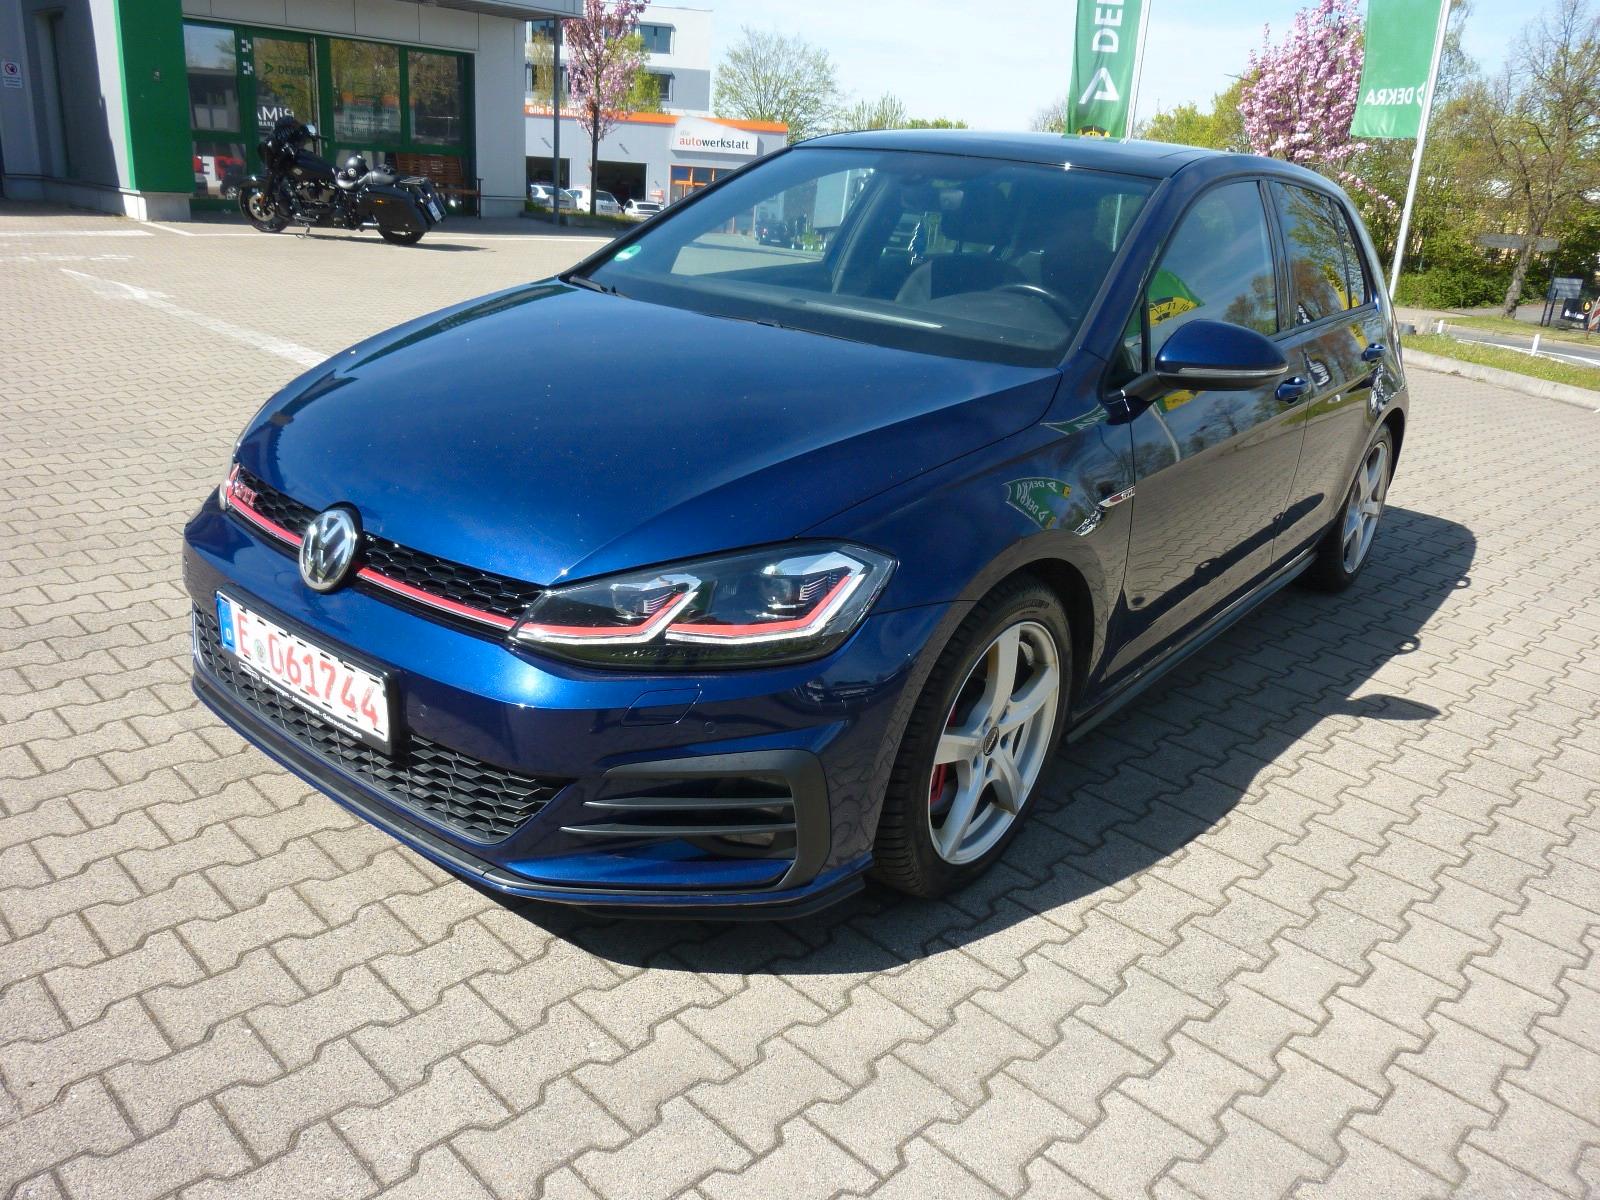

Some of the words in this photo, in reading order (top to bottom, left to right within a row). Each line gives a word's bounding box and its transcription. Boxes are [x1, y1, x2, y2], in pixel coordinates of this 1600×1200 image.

[1092, 0, 1124, 53] DE
[680, 138, 749, 150] autowerkstatt
[225, 627, 232, 640] D
[237, 612, 251, 656] E
[268, 632, 379, 728] 061744
